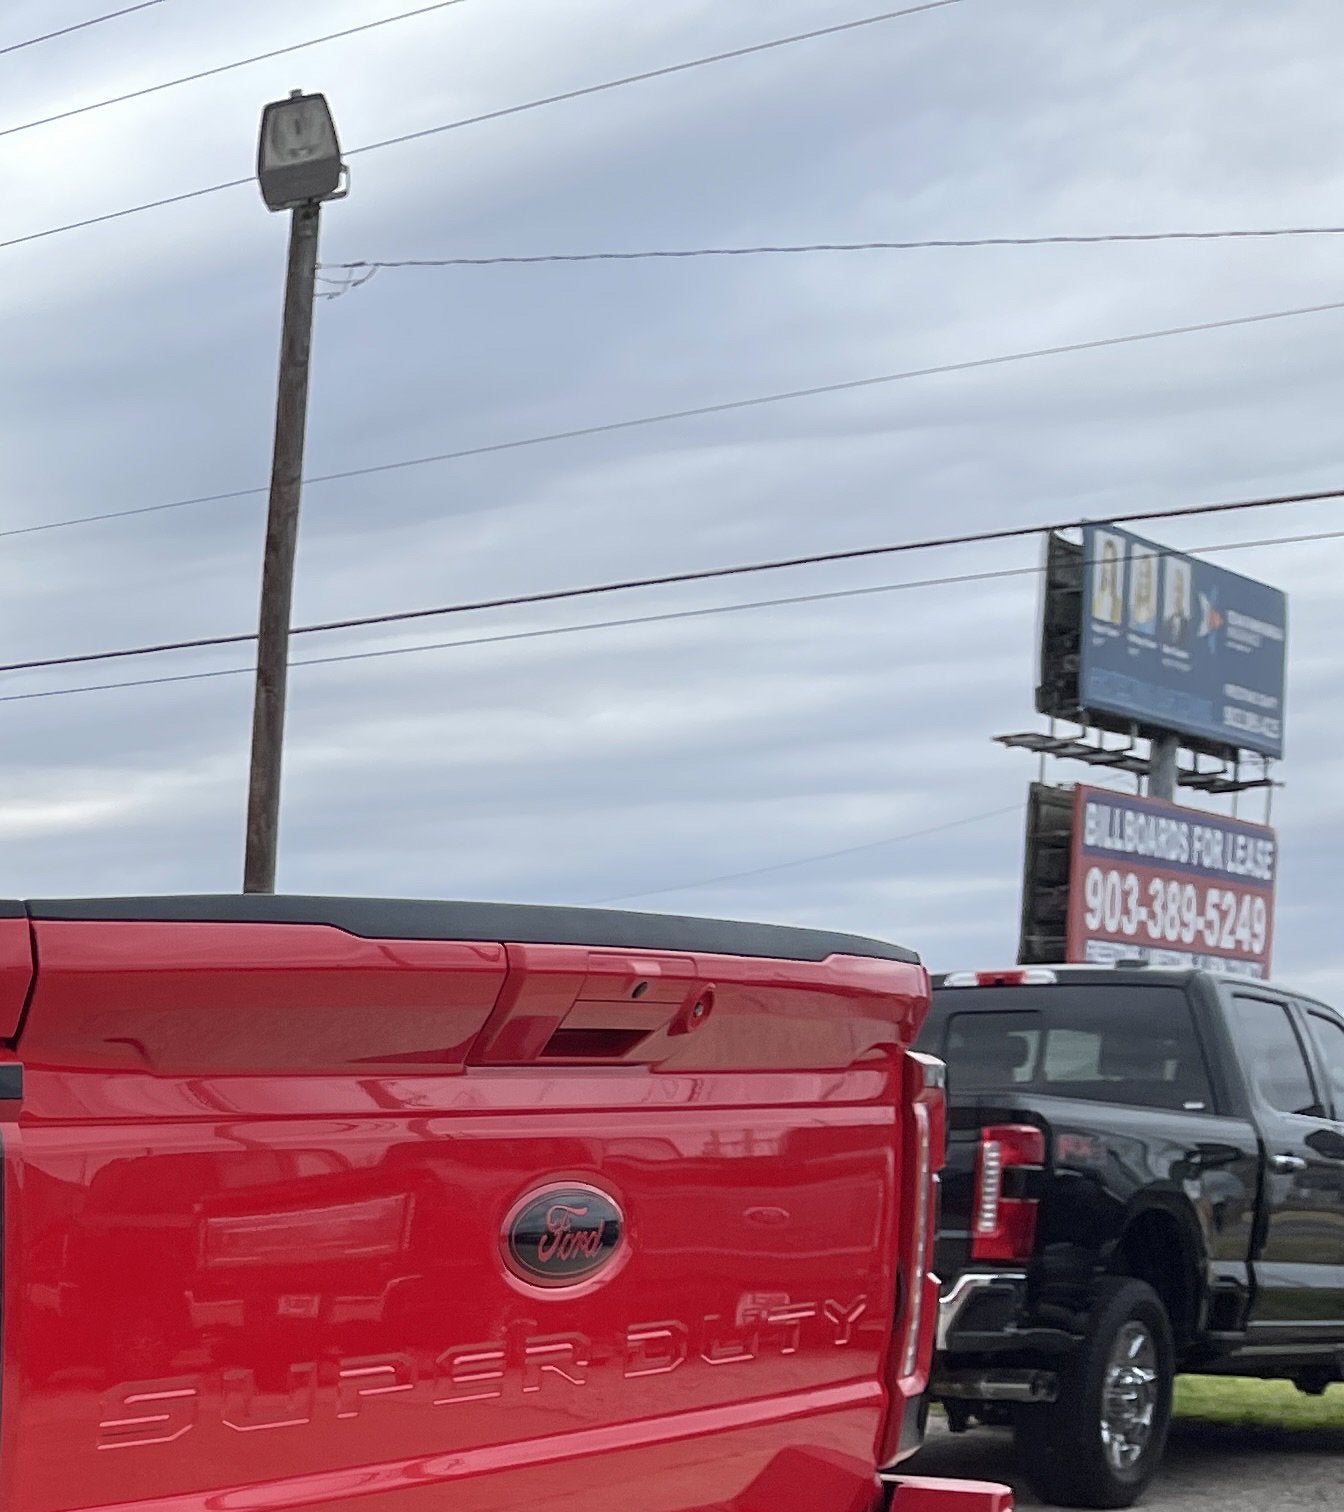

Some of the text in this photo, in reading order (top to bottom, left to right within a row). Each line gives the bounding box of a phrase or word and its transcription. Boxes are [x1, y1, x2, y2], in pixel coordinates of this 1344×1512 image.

[1192, 825, 1223, 869] FOR
[1226, 833, 1274, 881] LEASE
[1085, 867, 1267, 955] 903-389-5249
[538, 1204, 605, 1263] Ford
[96, 1294, 868, 1450] SUPER DUTY
